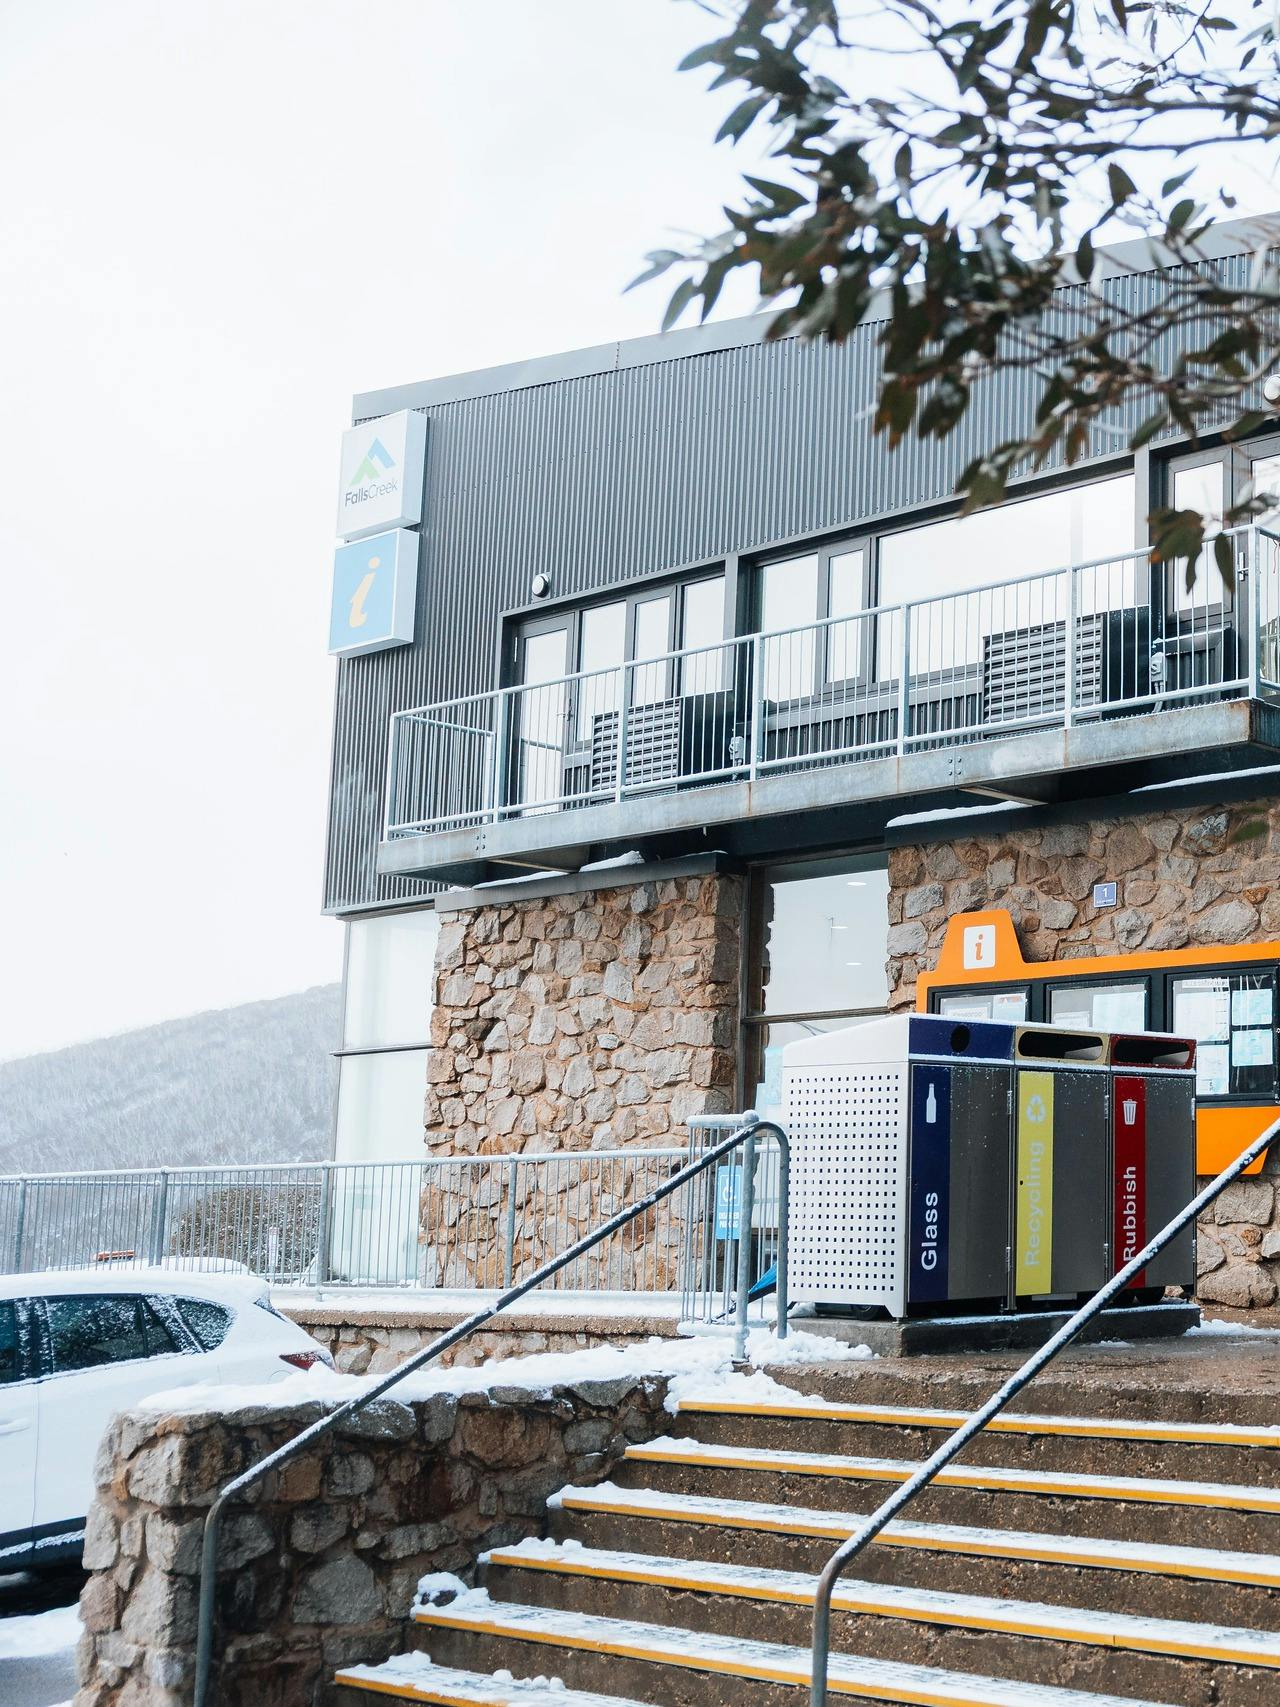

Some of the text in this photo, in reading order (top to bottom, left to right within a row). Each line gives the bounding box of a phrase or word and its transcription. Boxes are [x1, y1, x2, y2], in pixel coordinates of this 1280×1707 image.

[345, 478, 399, 507] FallsCreek
[921, 1192, 939, 1271] Glass
[1024, 1141, 1045, 1266] Recycling
[1123, 1166, 1137, 1261] Rubbish
